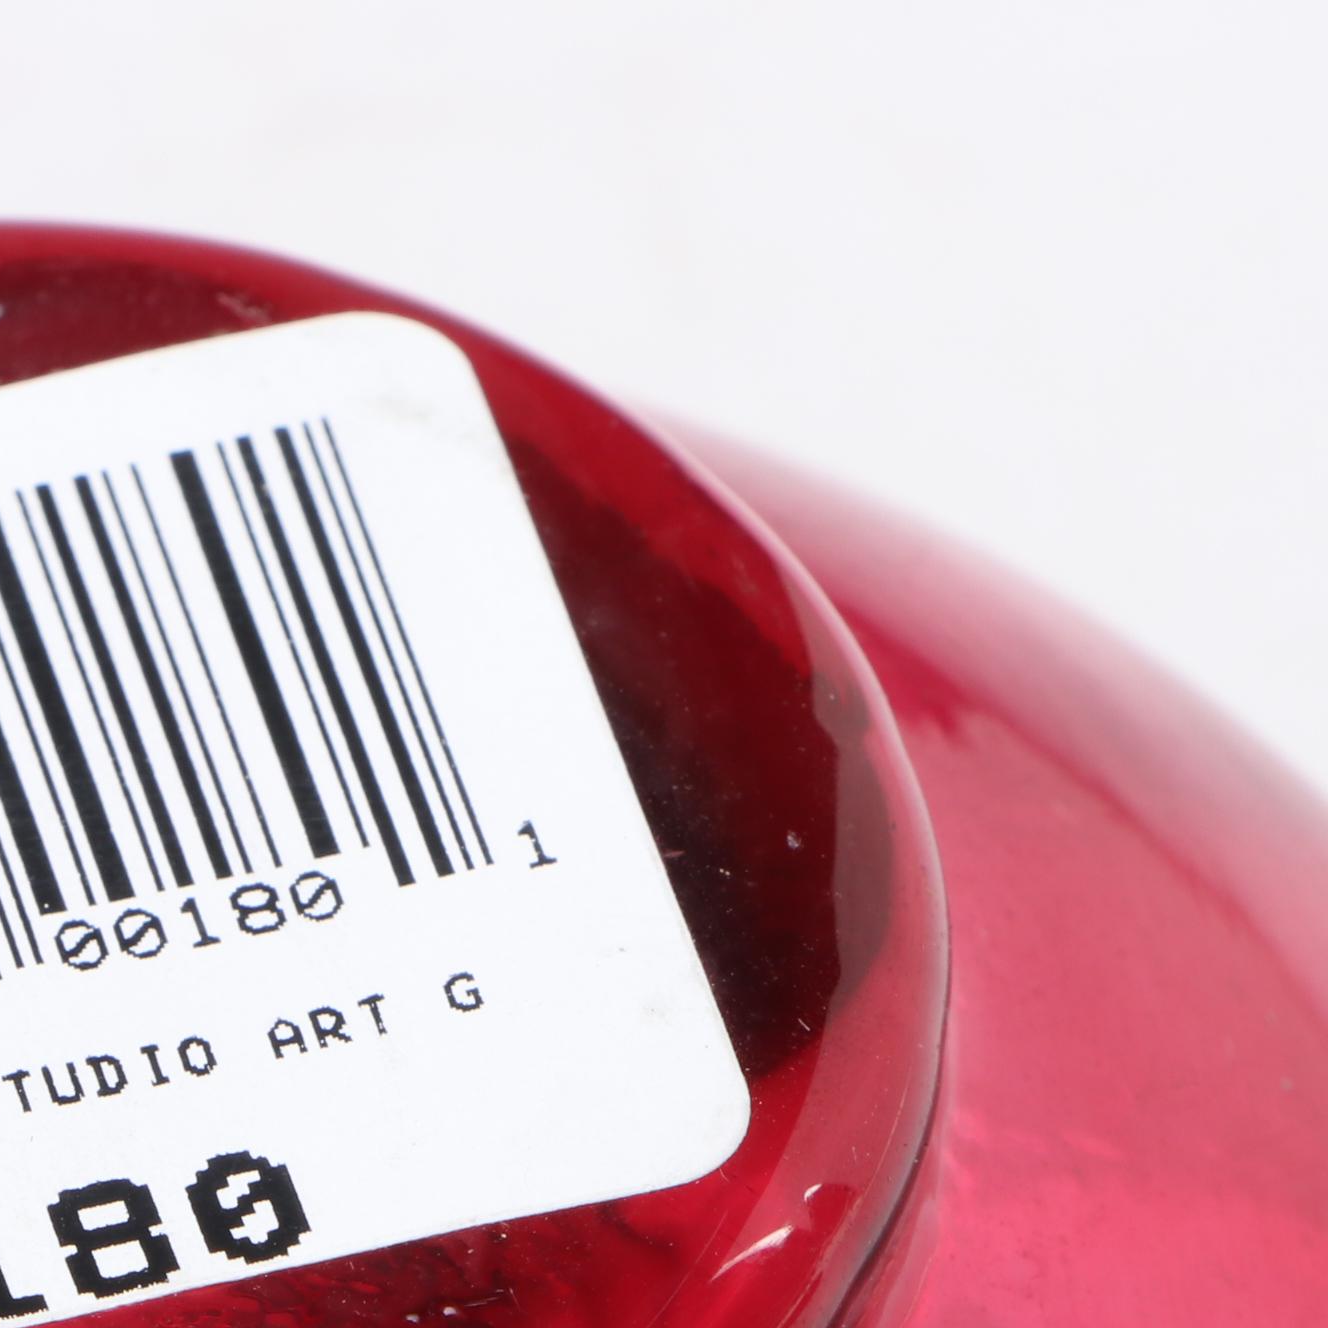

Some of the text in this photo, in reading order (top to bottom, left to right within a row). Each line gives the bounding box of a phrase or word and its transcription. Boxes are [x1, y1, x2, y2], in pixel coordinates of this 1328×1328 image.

[53, 870, 344, 972] 00180
[518, 822, 557, 869] 1
[266, 993, 387, 1060] ART
[443, 971, 484, 1013] G
